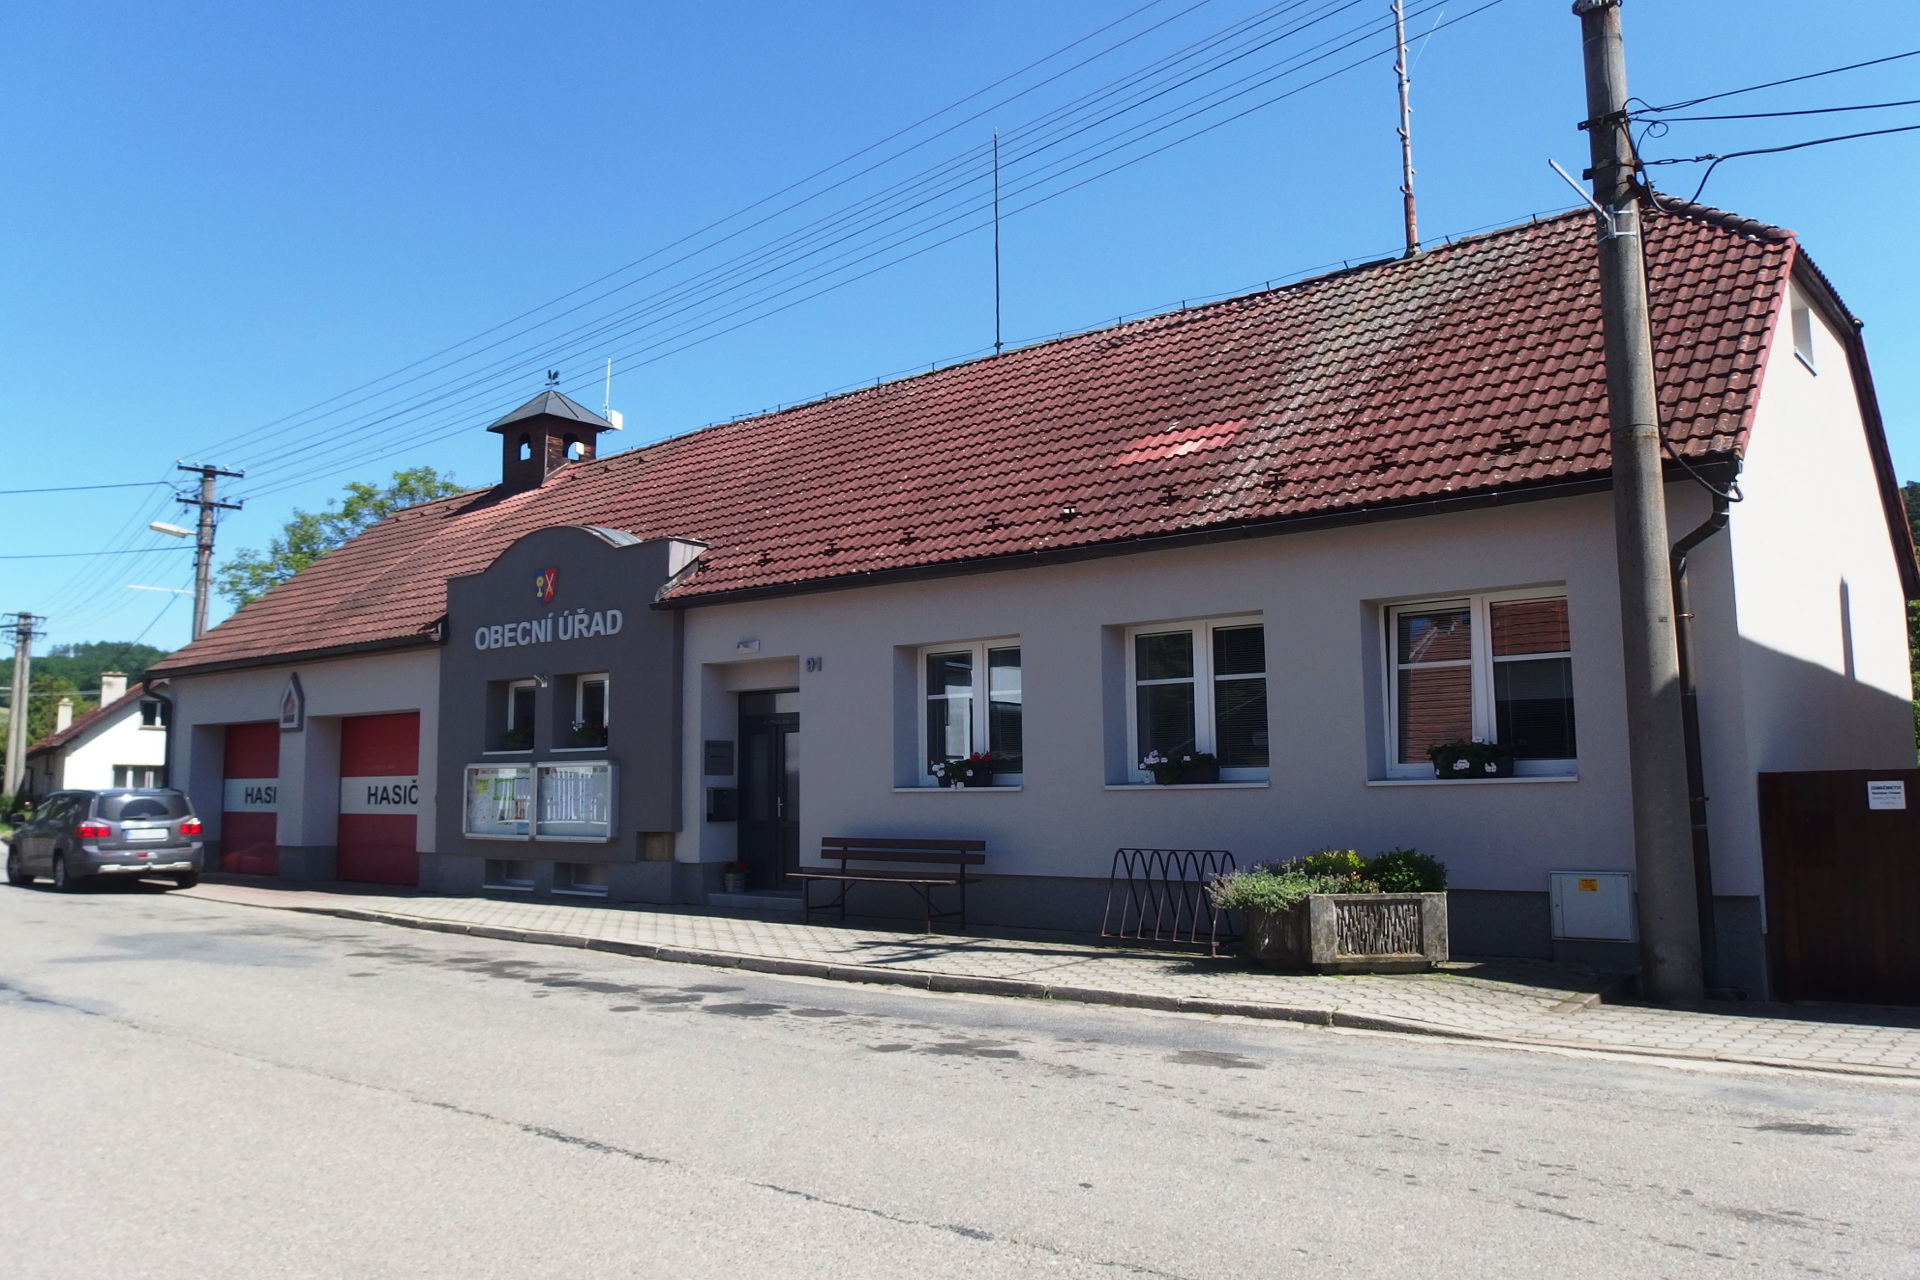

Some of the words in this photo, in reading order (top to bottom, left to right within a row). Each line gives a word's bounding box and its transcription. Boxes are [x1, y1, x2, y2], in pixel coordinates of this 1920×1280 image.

[474, 612, 554, 651] OBECNÍ
[558, 608, 624, 641] ÚŘAD
[806, 656, 823, 673] 91
